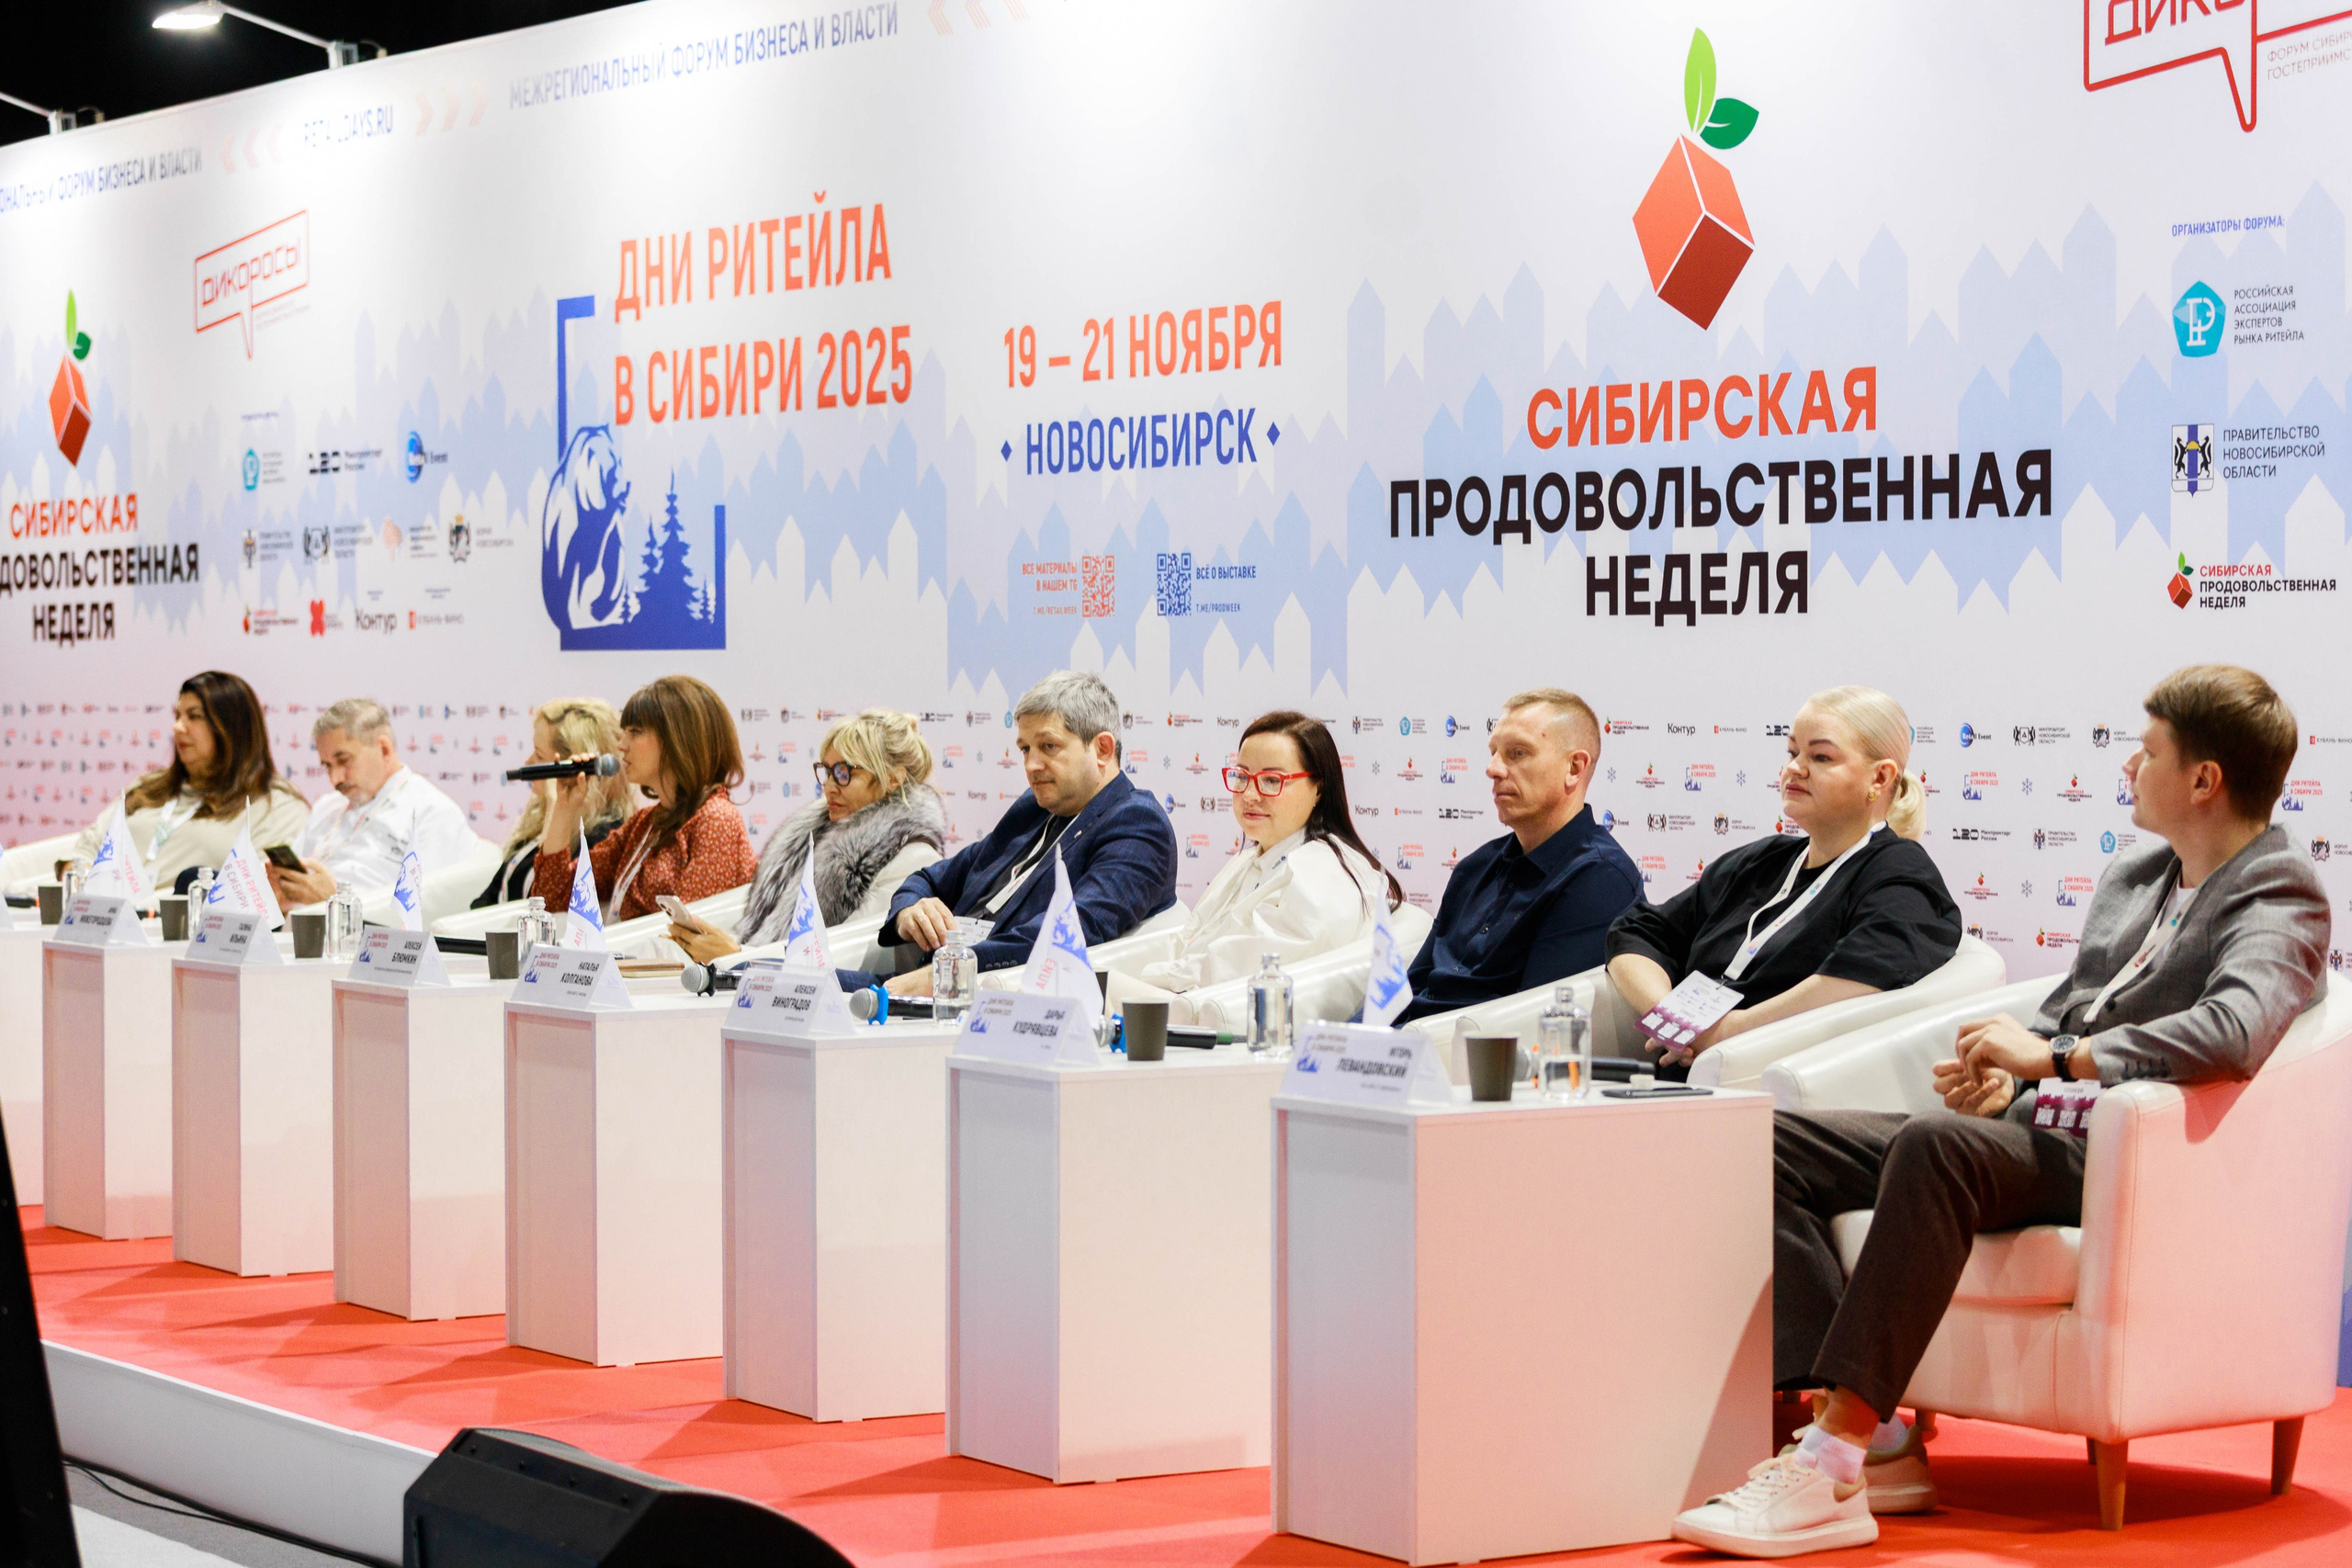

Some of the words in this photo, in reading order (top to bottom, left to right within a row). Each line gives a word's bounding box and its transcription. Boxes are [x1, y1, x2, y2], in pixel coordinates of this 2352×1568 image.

[510, 42, 666, 109] МЕЖРЕГИОНАЛЬНЫЙ
[672, 37, 729, 77] ФОРУМ
[735, 20, 808, 64] БИЗНЕСА
[814, 16, 825, 50] И
[831, 1, 898, 47] ВЛАСТИ
[2267, 40, 2309, 62] ФОРУМ
[97, 157, 146, 193] БИЗНЕСА
[149, 153, 158, 183] И
[159, 146, 203, 180] ВЛАСТИ
[2171, 219, 2242, 237] ОРГАНИЗАТОРЫ
[2243, 214, 2286, 231] ФОРУМА:
[615, 237, 694, 323] ДНИ
[707, 190, 893, 301] РИТЕЙЛА
[201, 238, 301, 307] ДИКОРОСЫ
[2233, 284, 2294, 300] РОССИЙСКАЯ
[2233, 299, 2296, 315] АССОЦИАЦИЯ
[2233, 316, 2283, 330] ЭКСПЕРТОВ
[1004, 324, 1037, 389] 19
[1048, 355, 1071, 367] –
[1082, 317, 1115, 382] 21
[1128, 299, 1283, 379] НОЯБРЯ
[2233, 333, 2263, 345] РЫНКА
[2265, 328, 2305, 344] РИТЕЙЛА
[615, 354, 635, 427] В
[647, 336, 804, 424] СИБИРИ
[817, 324, 913, 411] 2025
[1527, 366, 1877, 450] СИБИРСКАЯ
[1026, 407, 1258, 475] НОВОСИБИРСК
[2223, 424, 2320, 442] ПРАВИТЕЛЬСТВО
[2222, 441, 2325, 461] НОВОСИБИРСКОЙ
[2222, 465, 2277, 479] ОБЛАСТИ
[1389, 448, 2052, 546] ПРОДОВОЛЬСТВЕННАЯ
[10, 493, 138, 540] СИБИРСКАЯ
[1022, 562, 1035, 575] ВСЕ
[1035, 561, 1078, 575] МАТЕРИАЛЫ
[1196, 564, 1209, 580] ВСЁ
[1211, 567, 1216, 579] О
[1218, 566, 1257, 579] ВЫСТАВКЕ
[2199, 564, 2272, 578] СИБИРСКАЯ
[1043, 579, 1068, 592] НАШЕМ
[1586, 550, 1808, 626] НЕДЕЛЯ
[2199, 579, 2337, 595] ПРОДОВОЛЬСТВЕННАЯ
[2199, 596, 2246, 611] НЕДЕЛЯ
[33, 602, 115, 649] НЕДЕЛЯ
[1217, 716, 1239, 728] Контур
[1668, 723, 1696, 736] Контур
[1355, 805, 1379, 818] Контур
[560, 973, 594, 987] КОЛГАНОВА
[794, 984, 818, 995] АЛЕКСЕЙ
[772, 996, 811, 1011] ВИНОГРАДОВ
[1337, 1056, 1408, 1077] ЛЕВАНДОВСКИЙ
